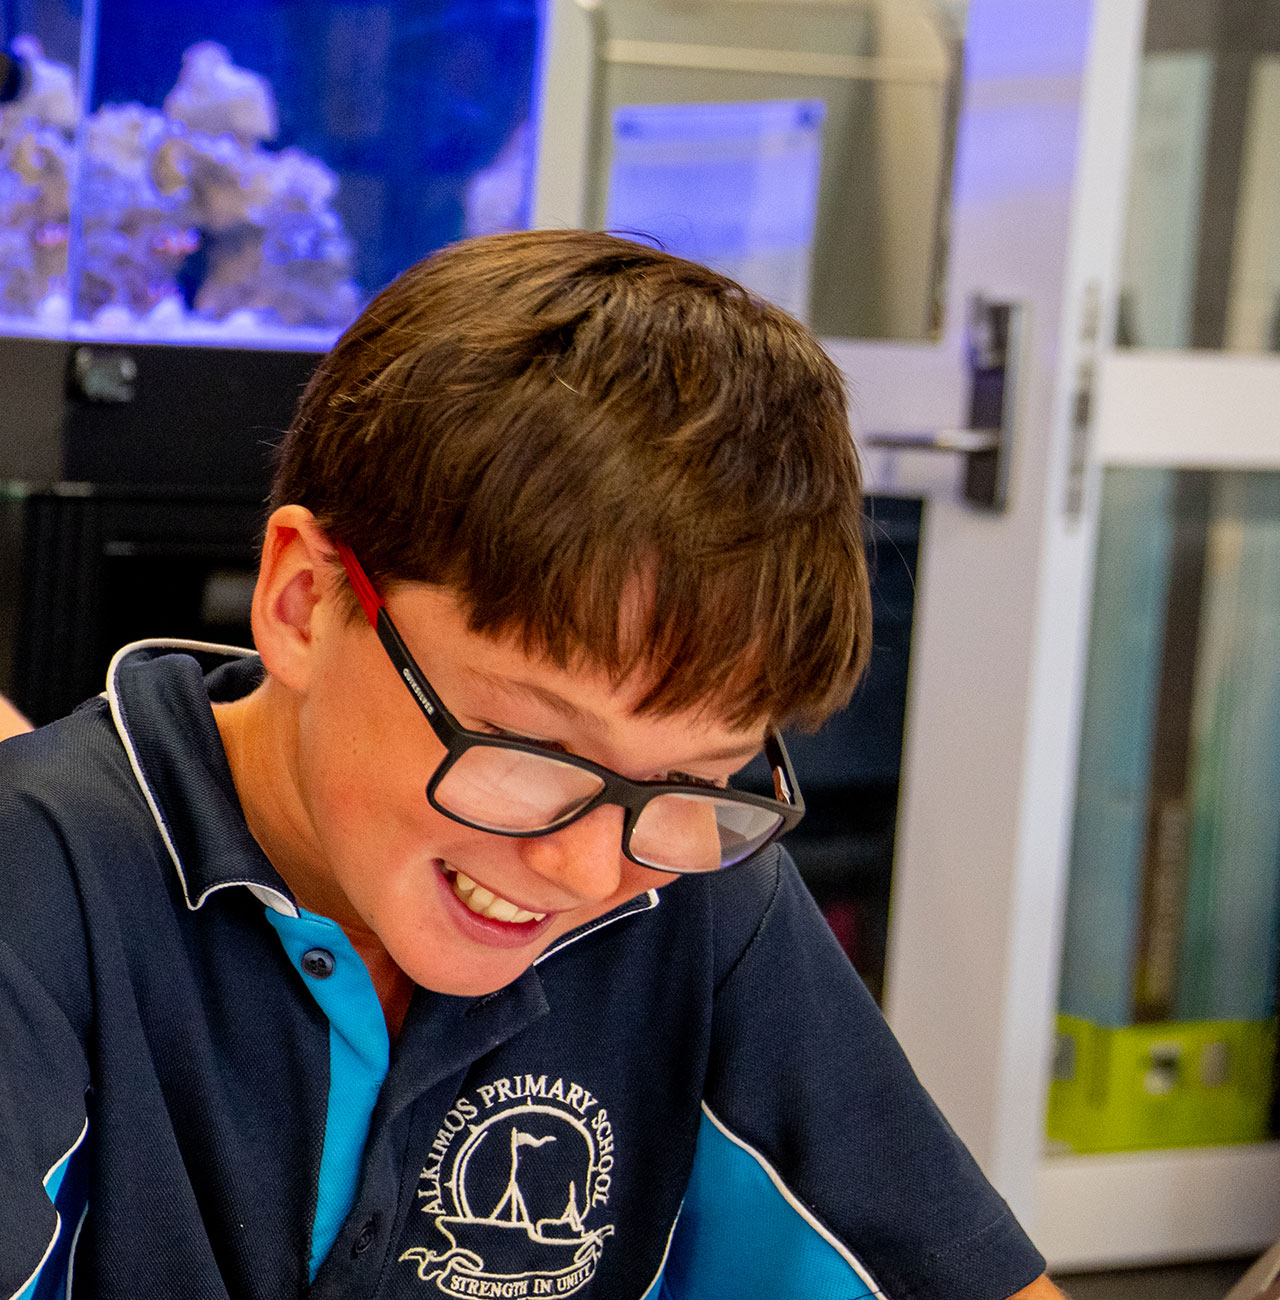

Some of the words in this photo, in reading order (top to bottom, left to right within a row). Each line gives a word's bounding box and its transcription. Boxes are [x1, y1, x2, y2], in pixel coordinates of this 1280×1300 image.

[417, 1097, 479, 1215] ALKIMOS
[476, 1074, 598, 1115] PRIMARY
[591, 1108, 615, 1208] SCHOOL
[450, 1274, 529, 1298] STRENGTH
[533, 1278, 554, 1294] IN
[556, 1261, 592, 1292] UNITY
